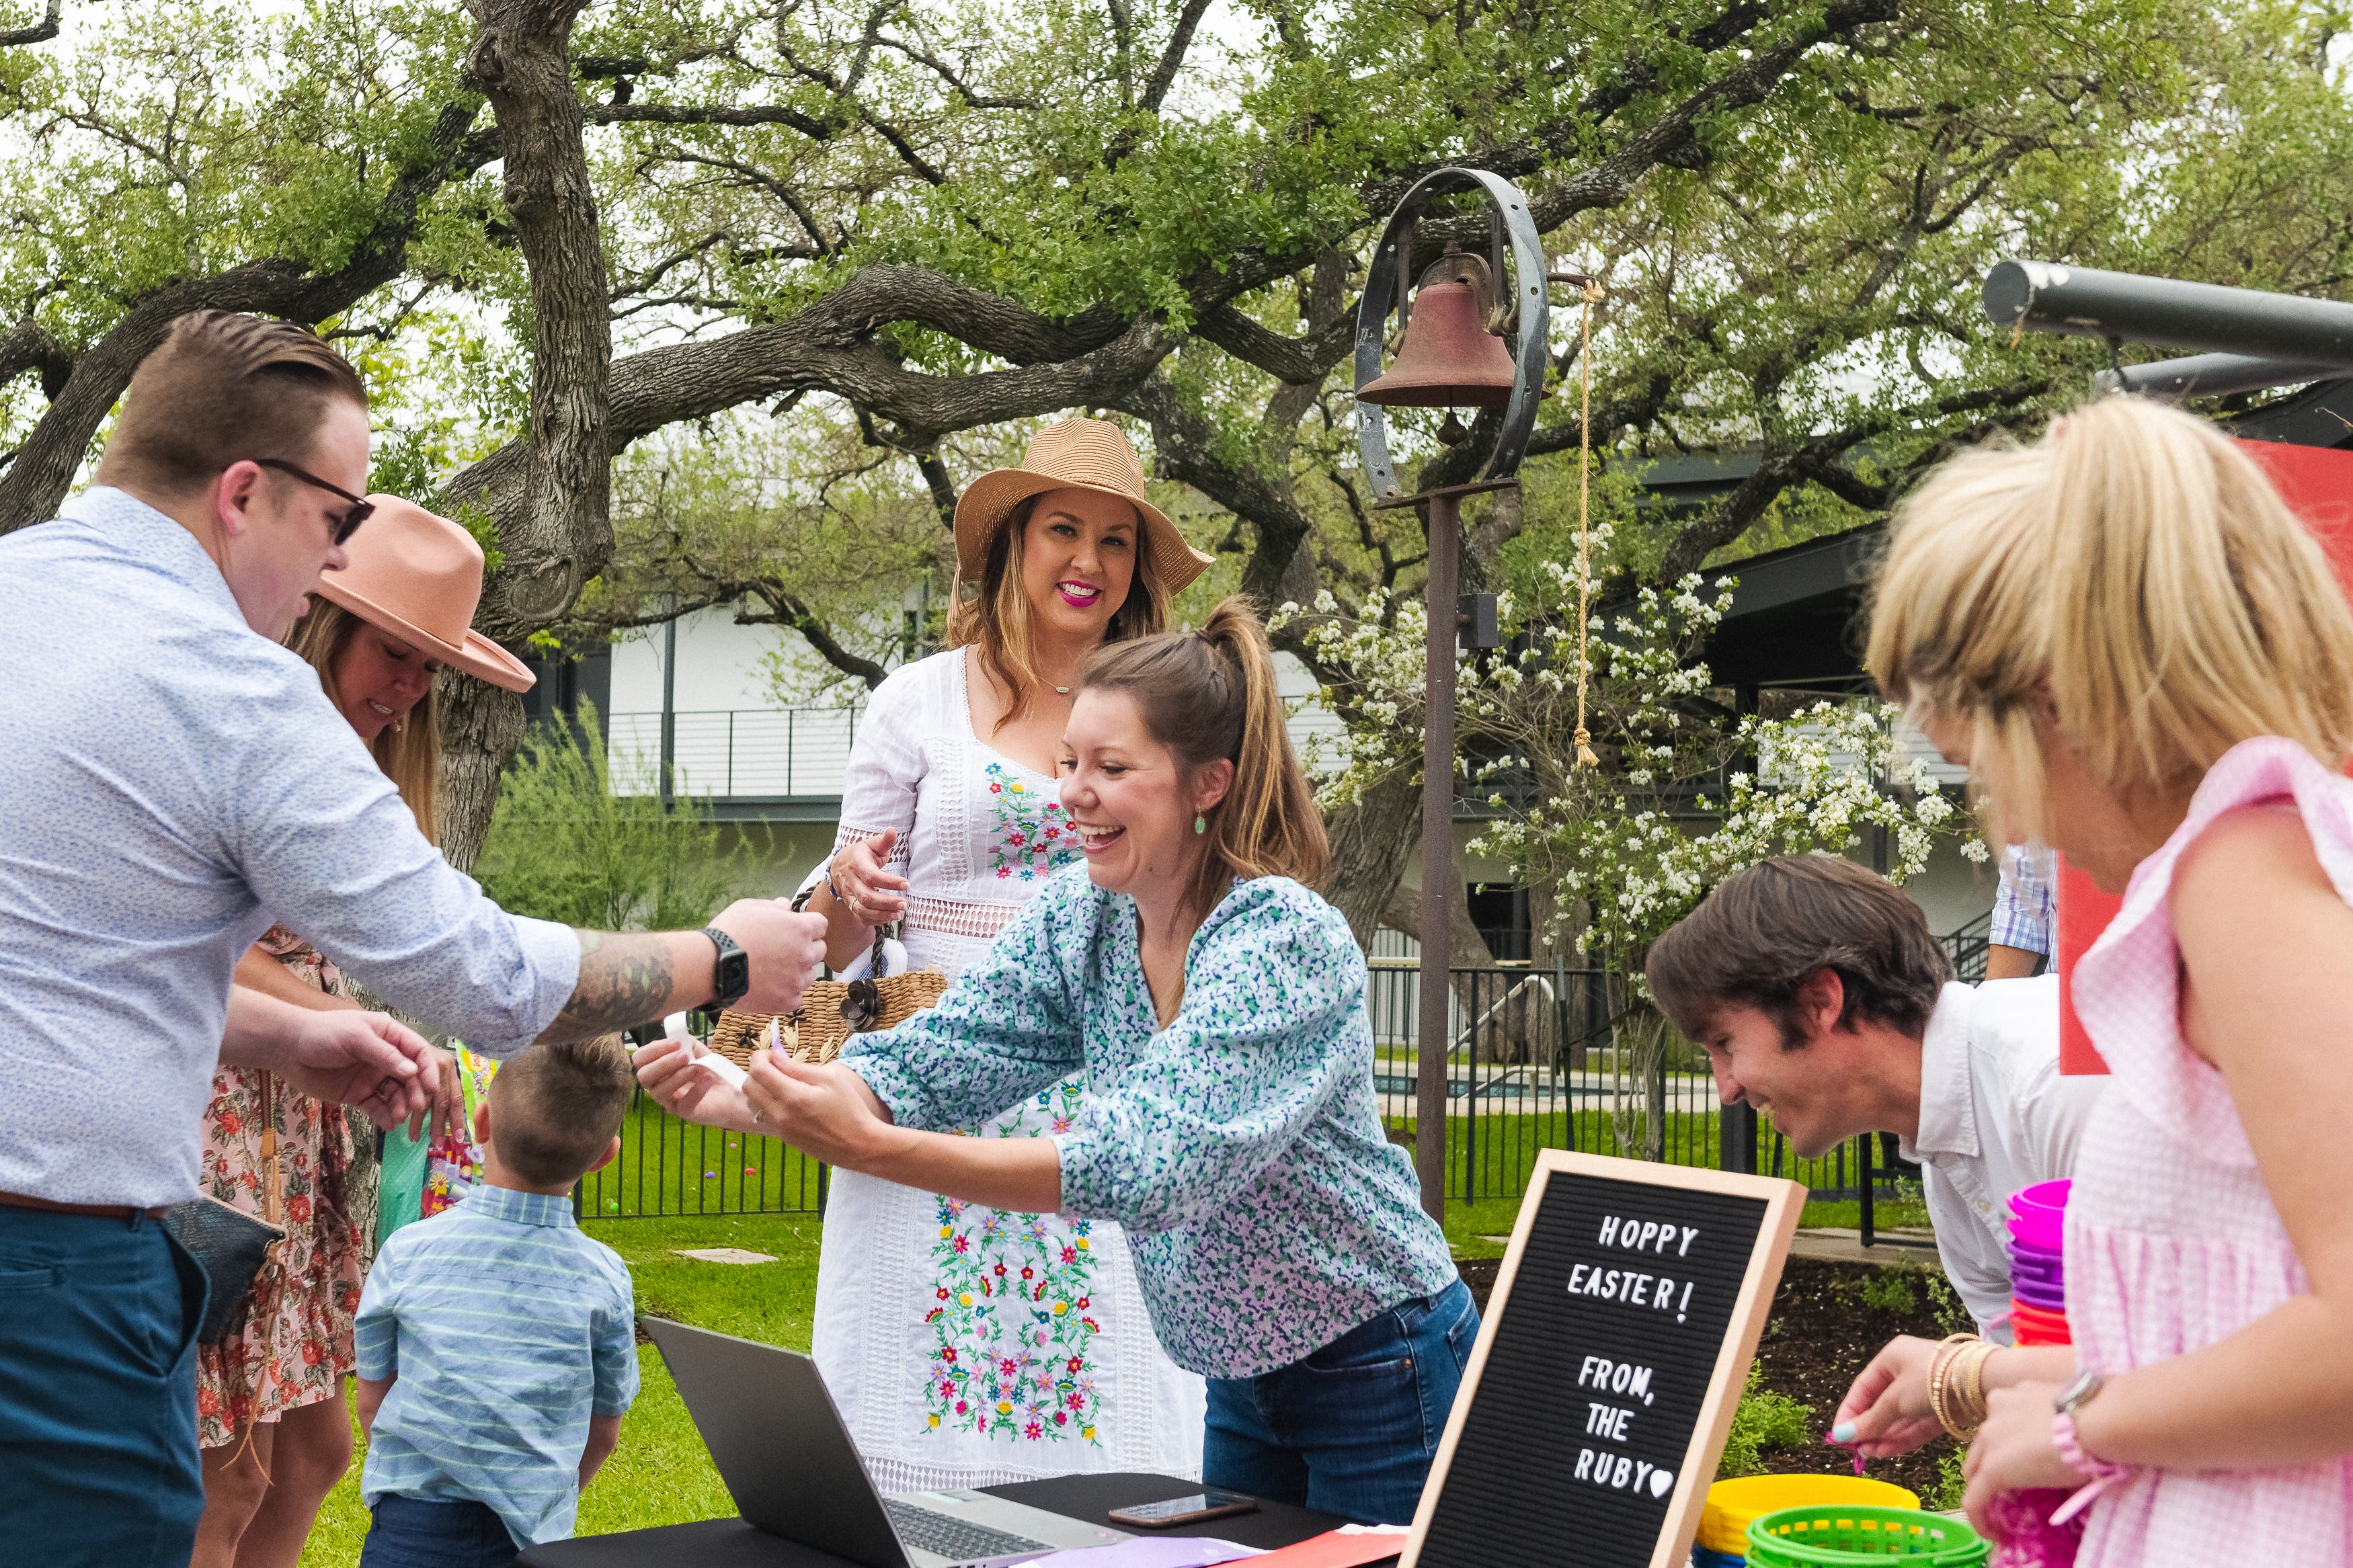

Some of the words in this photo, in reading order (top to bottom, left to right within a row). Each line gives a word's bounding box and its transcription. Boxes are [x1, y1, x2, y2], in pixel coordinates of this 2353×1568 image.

[1598, 1215, 1700, 1257] HOPPY
[1567, 1264, 1694, 1324] EASTER!
[1577, 1355, 1655, 1407] FROM,
[1586, 1402, 1635, 1442] THE
[1574, 1448, 1654, 1493] RUBY
